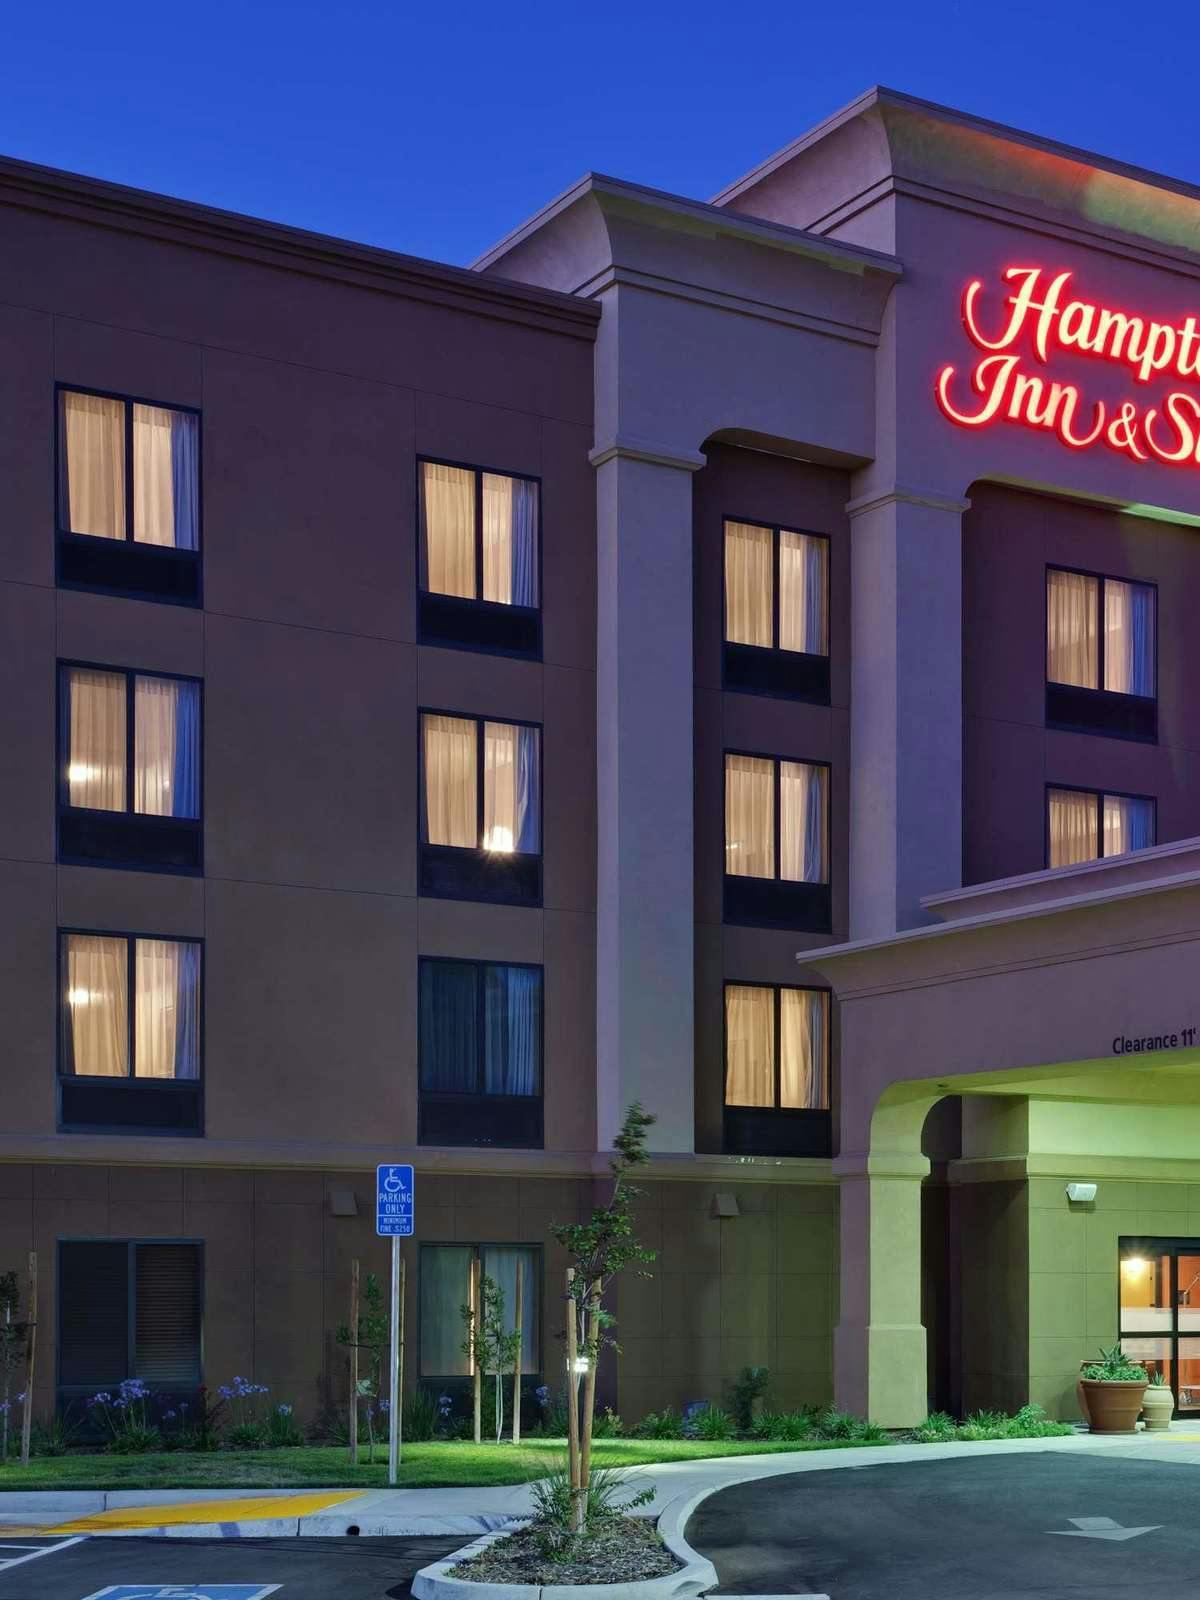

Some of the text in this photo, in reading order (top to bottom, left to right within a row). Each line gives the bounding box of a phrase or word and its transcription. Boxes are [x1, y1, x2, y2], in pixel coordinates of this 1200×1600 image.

[938, 354, 1106, 447] Inn
[1107, 402, 1148, 460] &
[1111, 1034, 1178, 1055] Clearance
[1181, 1027, 1197, 1047] 11'
[379, 1192, 412, 1204] PARKING
[385, 1203, 406, 1215] ONLY
